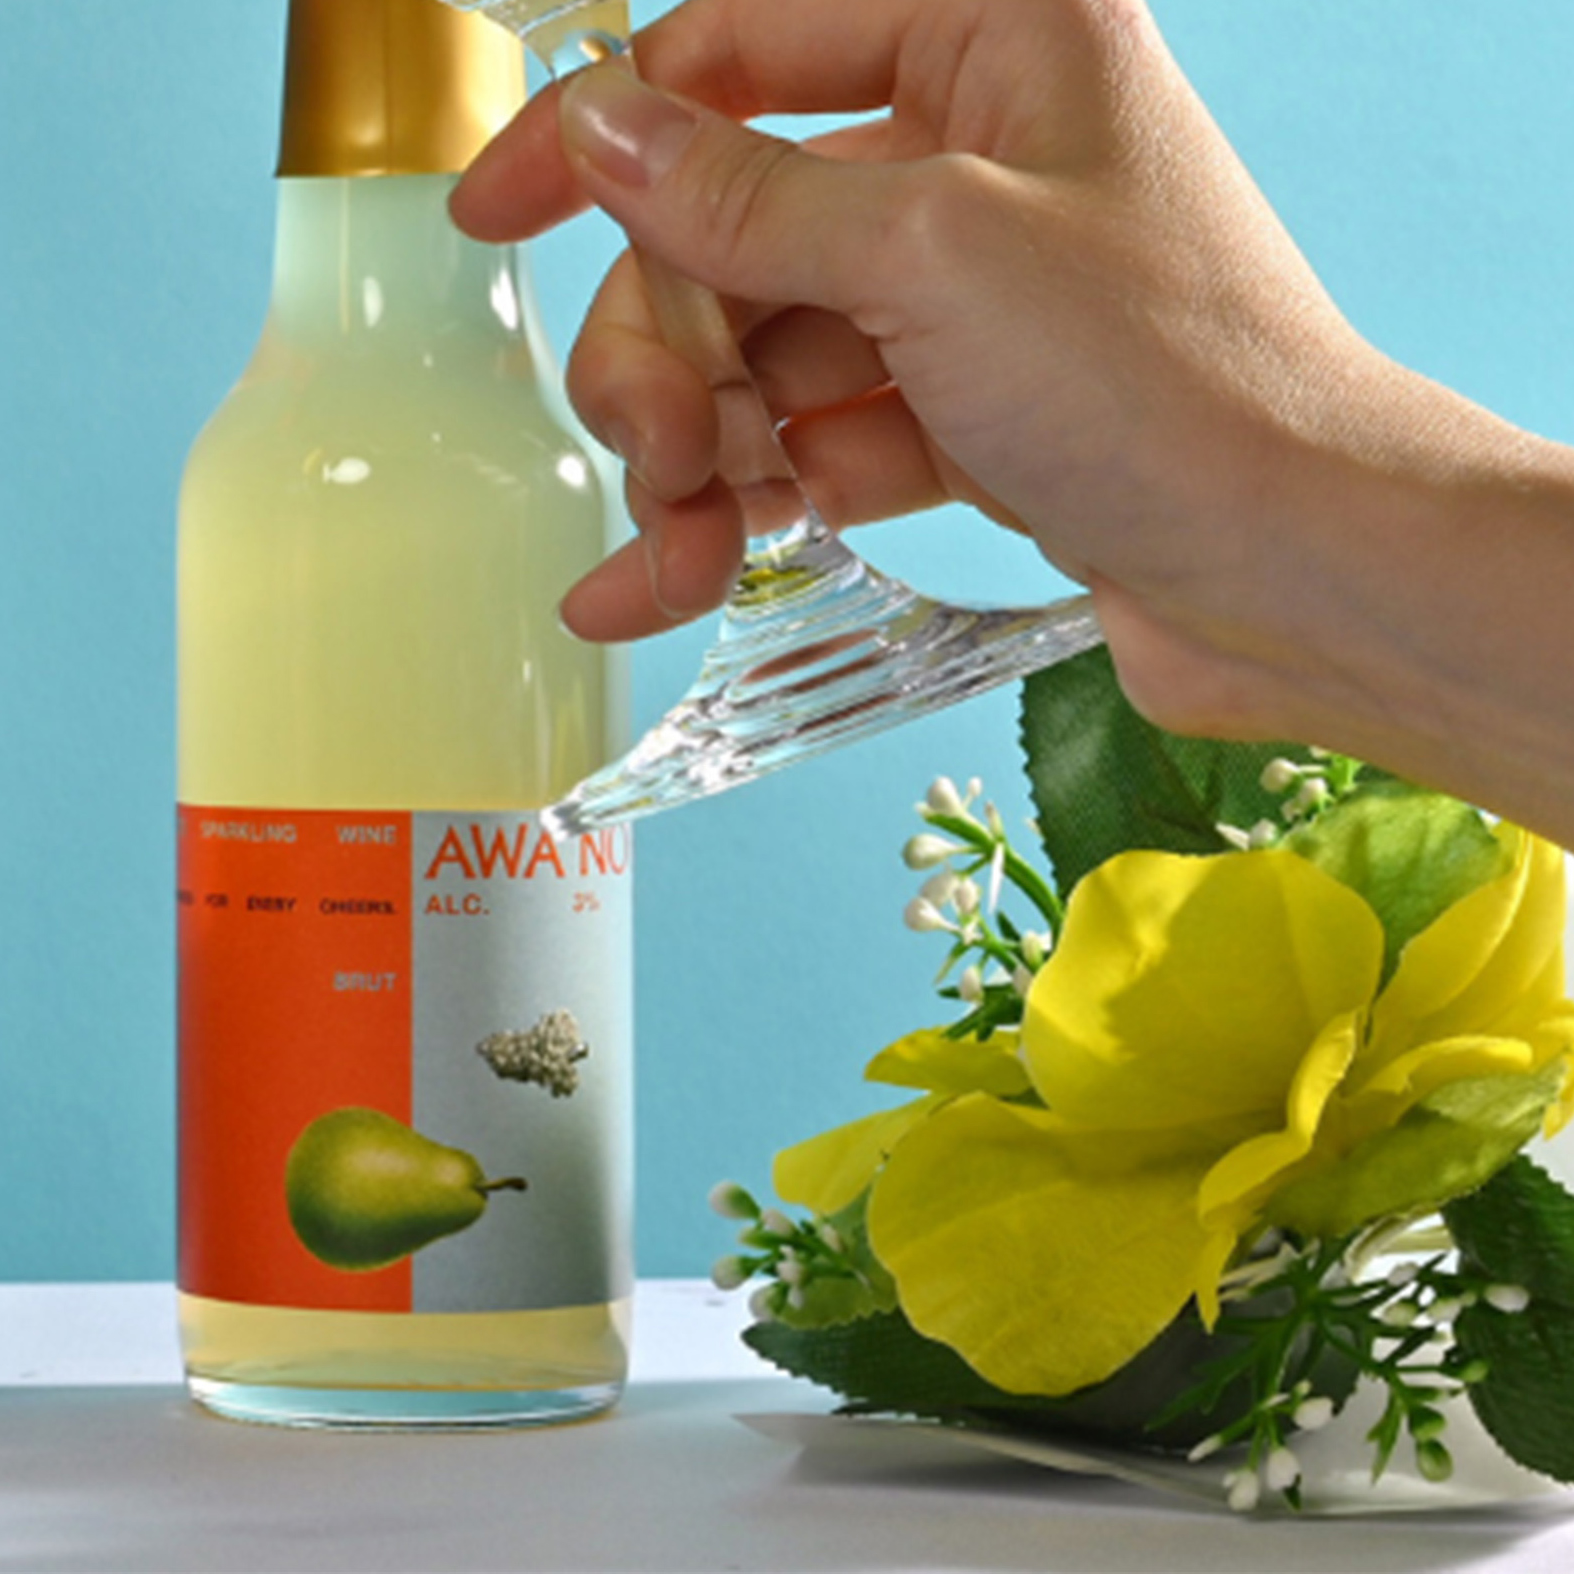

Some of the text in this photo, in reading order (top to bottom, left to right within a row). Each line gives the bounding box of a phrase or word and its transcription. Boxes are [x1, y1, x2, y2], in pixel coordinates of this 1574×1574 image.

[200, 820, 297, 843] SPARKLING
[337, 824, 397, 844] WINE
[424, 892, 490, 916] ALC.
[334, 972, 396, 991] BRUT
